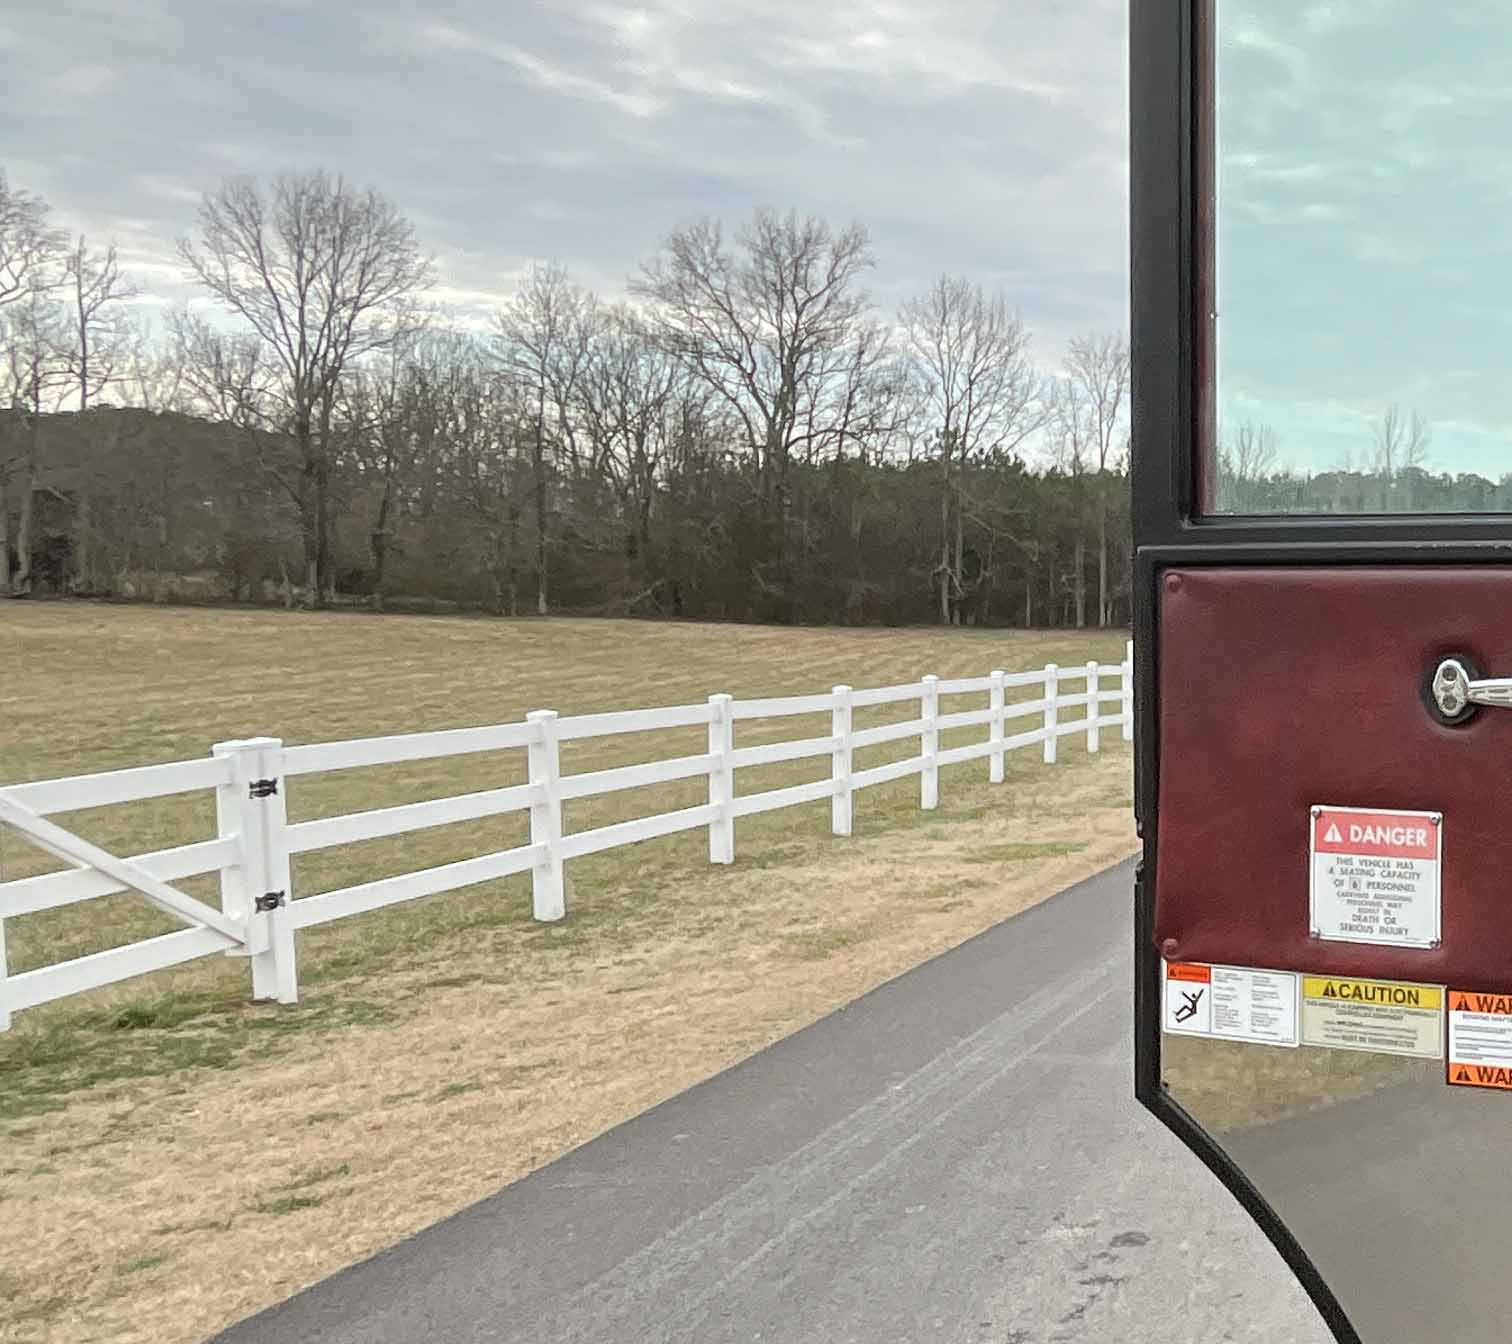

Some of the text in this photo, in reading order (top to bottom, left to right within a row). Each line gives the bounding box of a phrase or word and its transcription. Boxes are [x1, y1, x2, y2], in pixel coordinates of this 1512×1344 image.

[1349, 824, 1428, 847] DANGER
[1336, 857, 1414, 869] THIS VEHICLE HAS
[1328, 866, 1421, 880] A SEATING CAPACITY
[1333, 879, 1345, 887] OF
[1366, 881, 1416, 892] PERSONNEL
[1351, 914, 1397, 925] DEATH OR
[1340, 922, 1408, 935] SERIOUS INJURY
[1338, 983, 1420, 1006] CAUTION
